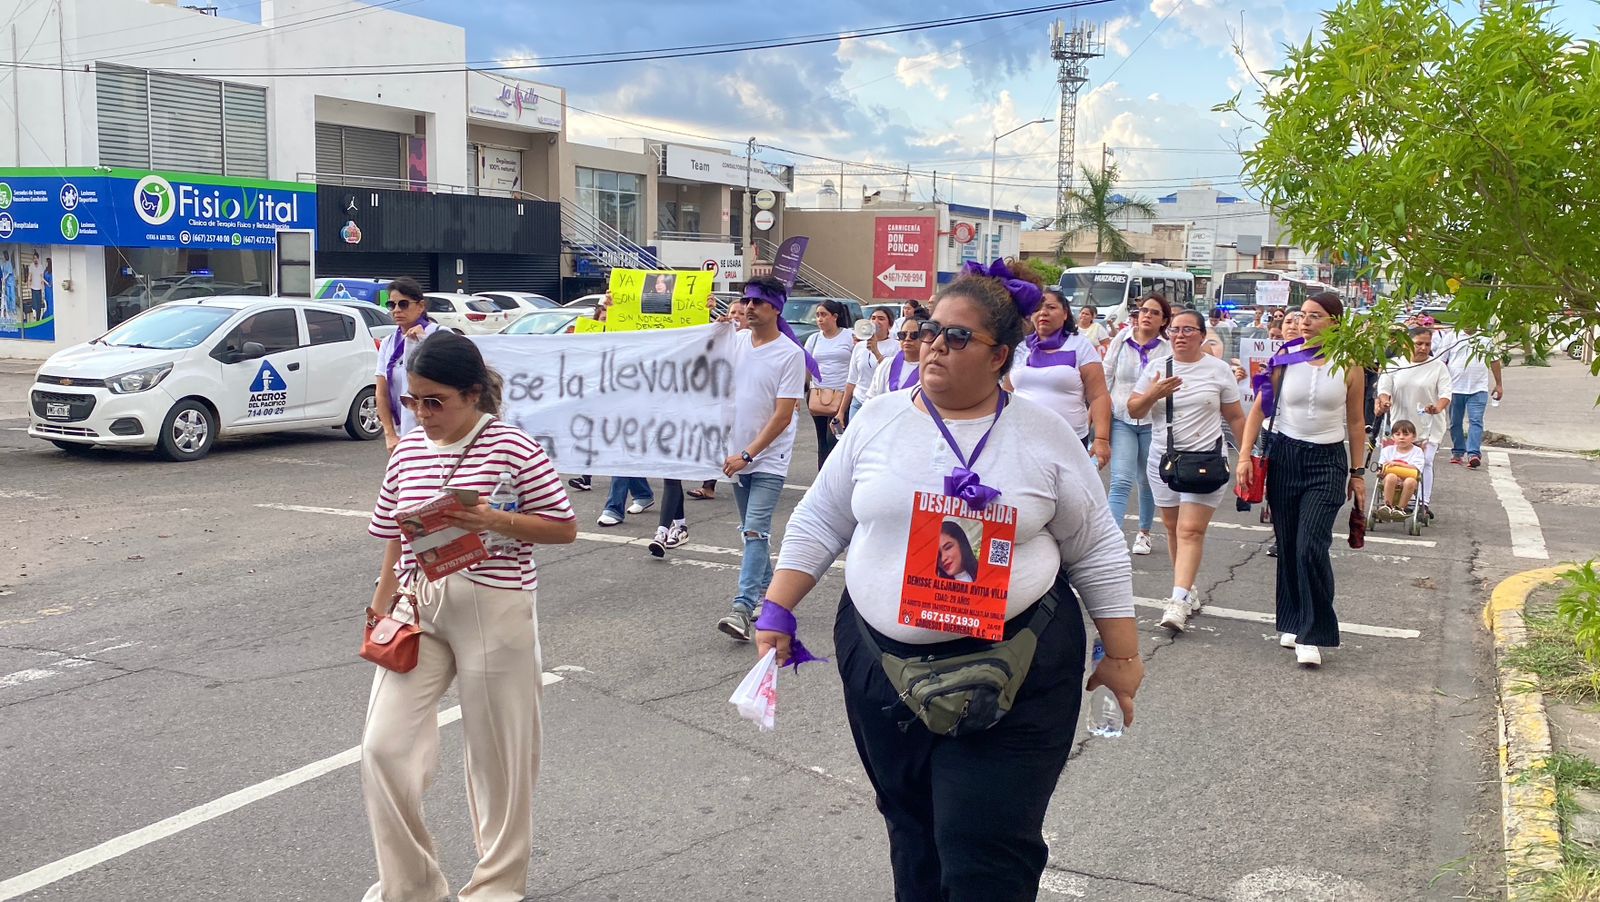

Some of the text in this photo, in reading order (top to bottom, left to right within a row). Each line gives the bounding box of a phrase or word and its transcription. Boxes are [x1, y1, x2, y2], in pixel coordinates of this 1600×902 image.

[691, 159, 710, 172] Team
[179, 185, 298, 223] FisioVital
[208, 219, 216, 227] de
[887, 224, 921, 232] CARNICERÍA
[192, 233, 206, 243] (667)
[206, 234, 216, 242] 257
[243, 235, 255, 244] (667)
[888, 234, 904, 243] DON
[887, 243, 919, 253] PONCHO
[720, 259, 742, 268] SE USARA
[725, 271, 737, 279] GRUA
[1094, 274, 1127, 284] HUIZACHES
[618, 275, 635, 287] YA
[686, 275, 697, 295] 7
[612, 293, 636, 304] SON
[619, 315, 634, 323] SIN
[637, 315, 673, 324] NOTICIAS
[1254, 341, 1265, 352] NO
[508, 372, 545, 401] se
[559, 352, 584, 399] la
[249, 392, 287, 402] ACEROS
[247, 407, 284, 418] 714 00 25
[907, 574, 932, 589] DENISSE
[932, 580, 969, 594] ALEJANDRA
[991, 589, 1008, 599] VILLA
[957, 595, 971, 605] AÑOS
[921, 610, 980, 628] 6671571930
